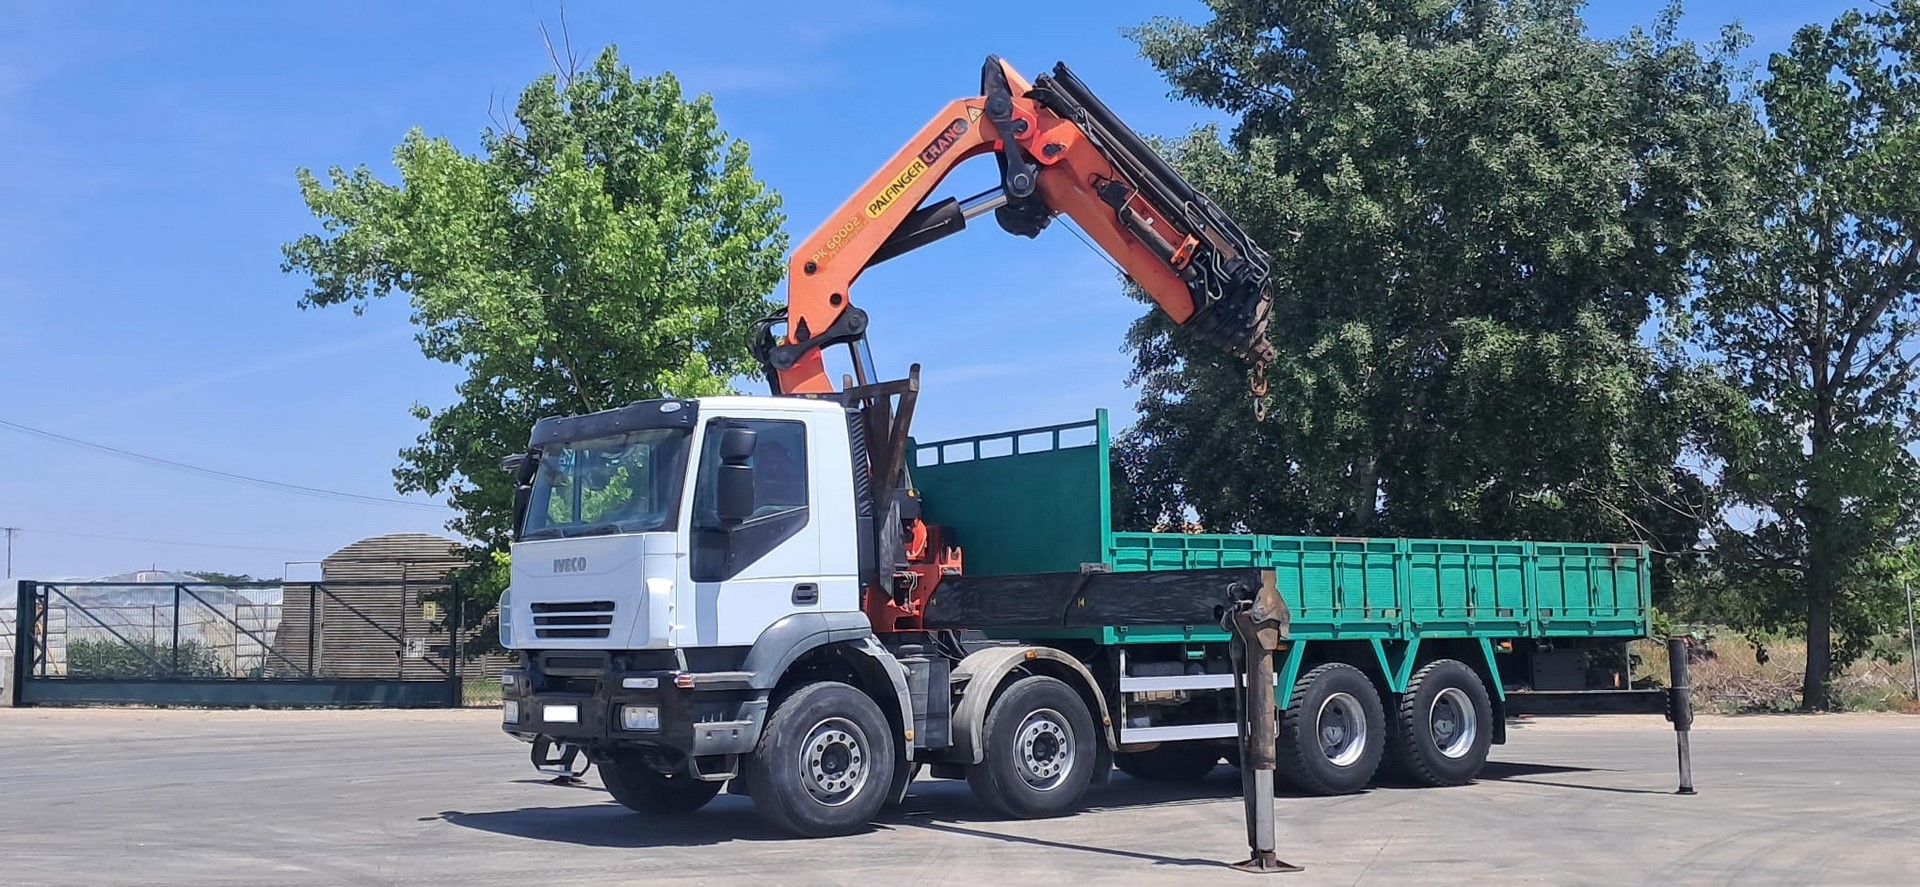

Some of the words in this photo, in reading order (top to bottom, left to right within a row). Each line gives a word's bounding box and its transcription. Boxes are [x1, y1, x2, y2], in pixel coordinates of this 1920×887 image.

[868, 161, 925, 216] PALFINGER
[811, 248, 828, 264] PK
[826, 216, 861, 250] 60002
[553, 556, 587, 573] IVECO
